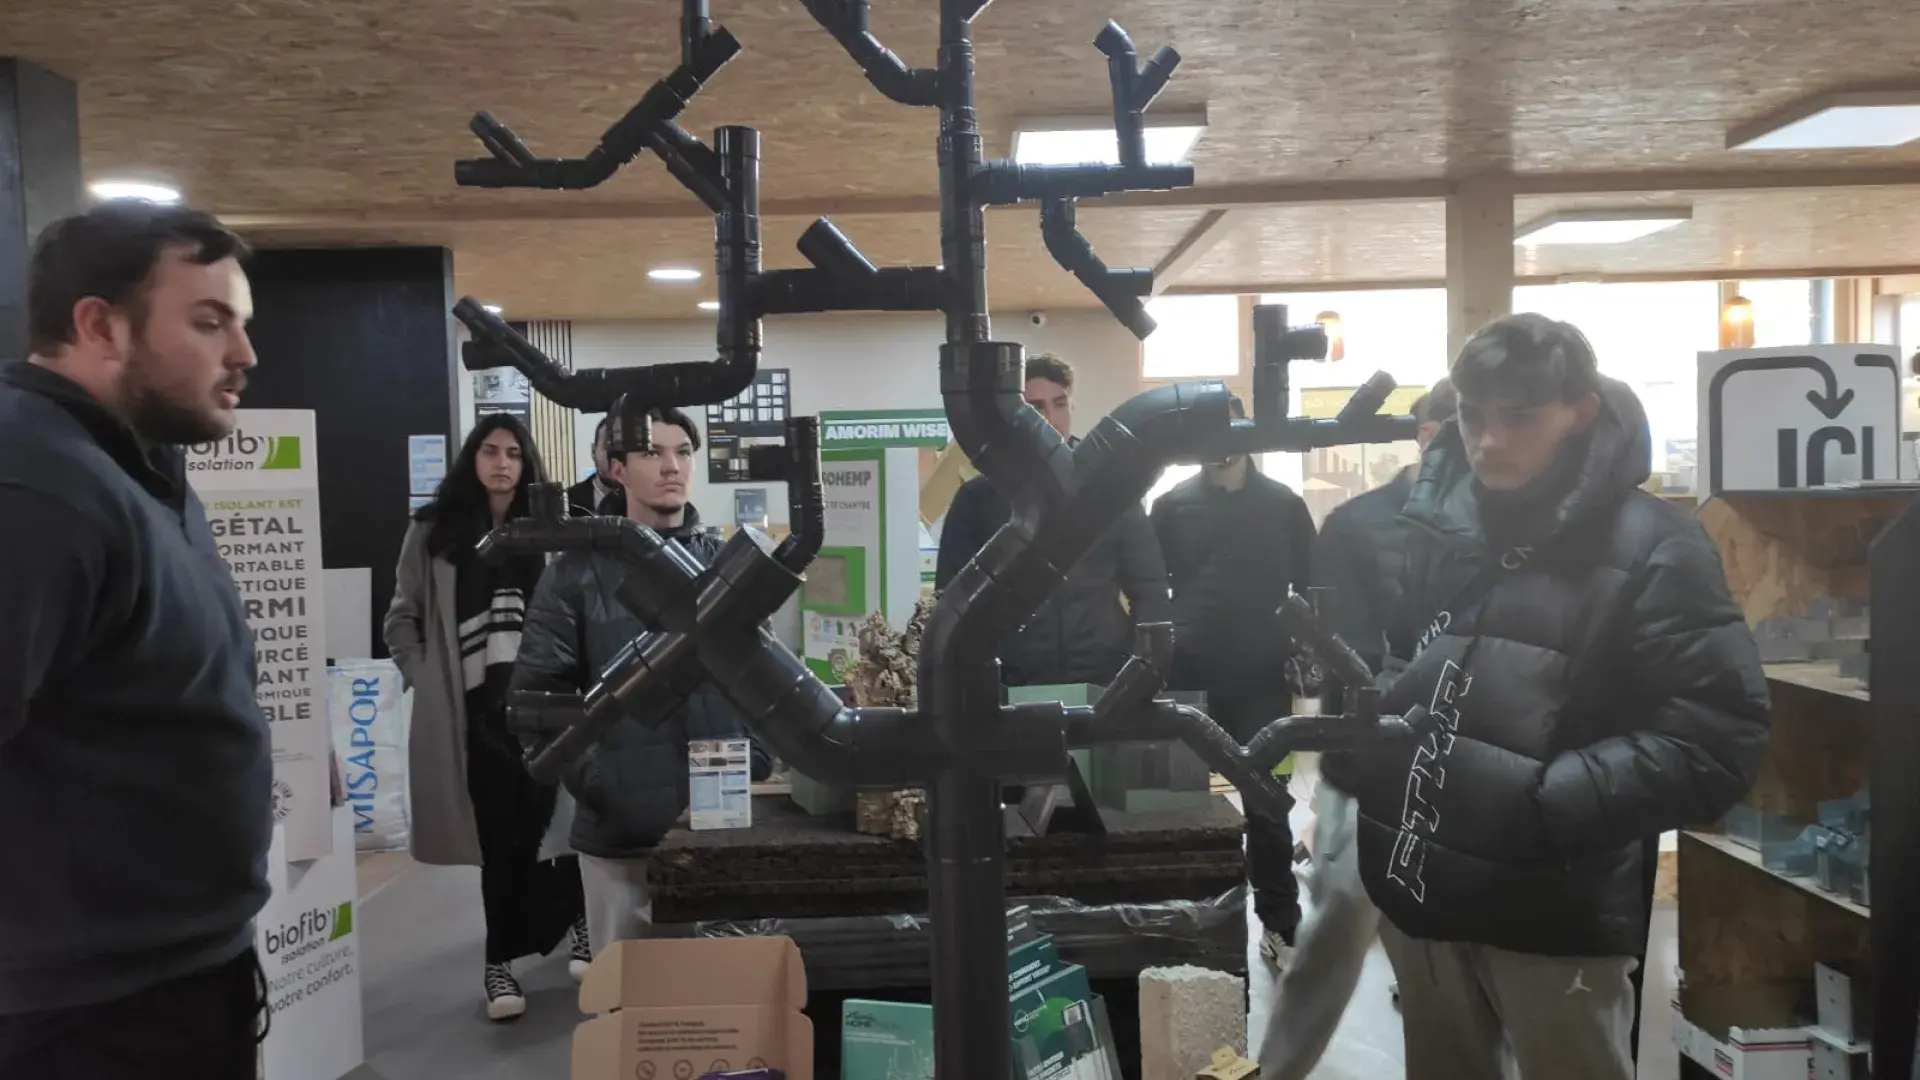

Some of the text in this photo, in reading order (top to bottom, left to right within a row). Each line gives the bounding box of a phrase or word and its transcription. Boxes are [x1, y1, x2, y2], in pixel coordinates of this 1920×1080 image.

[825, 423, 947, 439] AMORIM WISE
[188, 460, 254, 471] solation
[215, 500, 273, 511] ISOLANT
[279, 499, 303, 509] EST
[210, 512, 303, 537] GÉTAL
[219, 541, 304, 556] ORMANT
[229, 559, 305, 574] RTABLE
[244, 596, 306, 619] RMI
[253, 625, 308, 641] IQUE
[259, 667, 310, 685] ANT
[256, 687, 311, 699] RMIQUE
[261, 702, 311, 721] BLE
[346, 677, 380, 833] MISAPOR
[266, 908, 326, 954] biofib
